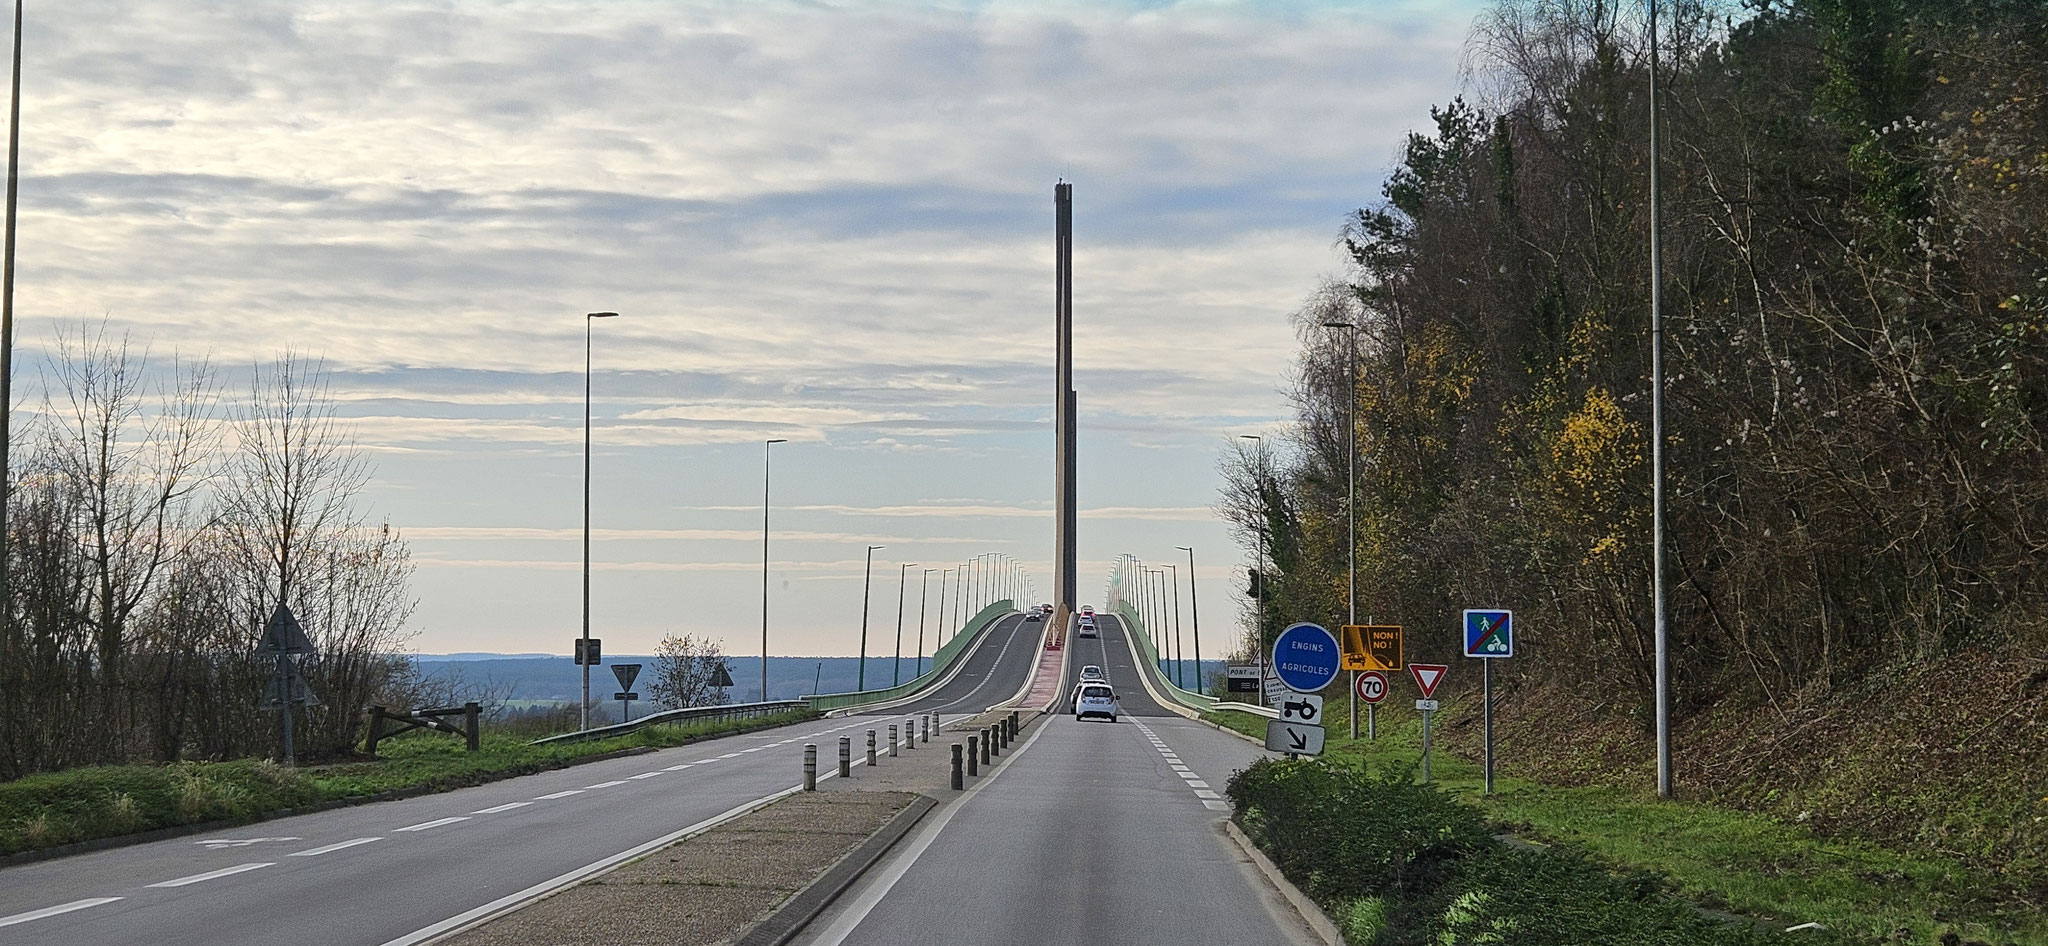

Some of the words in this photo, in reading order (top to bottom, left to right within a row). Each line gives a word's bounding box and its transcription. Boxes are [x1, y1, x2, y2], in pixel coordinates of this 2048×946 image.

[1373, 631, 1393, 640] NON
[1291, 641, 1324, 652] ENGINS
[1373, 641, 1387, 649] NO
[1282, 662, 1329, 676] AGRICOLES
[1363, 681, 1382, 694] 70
